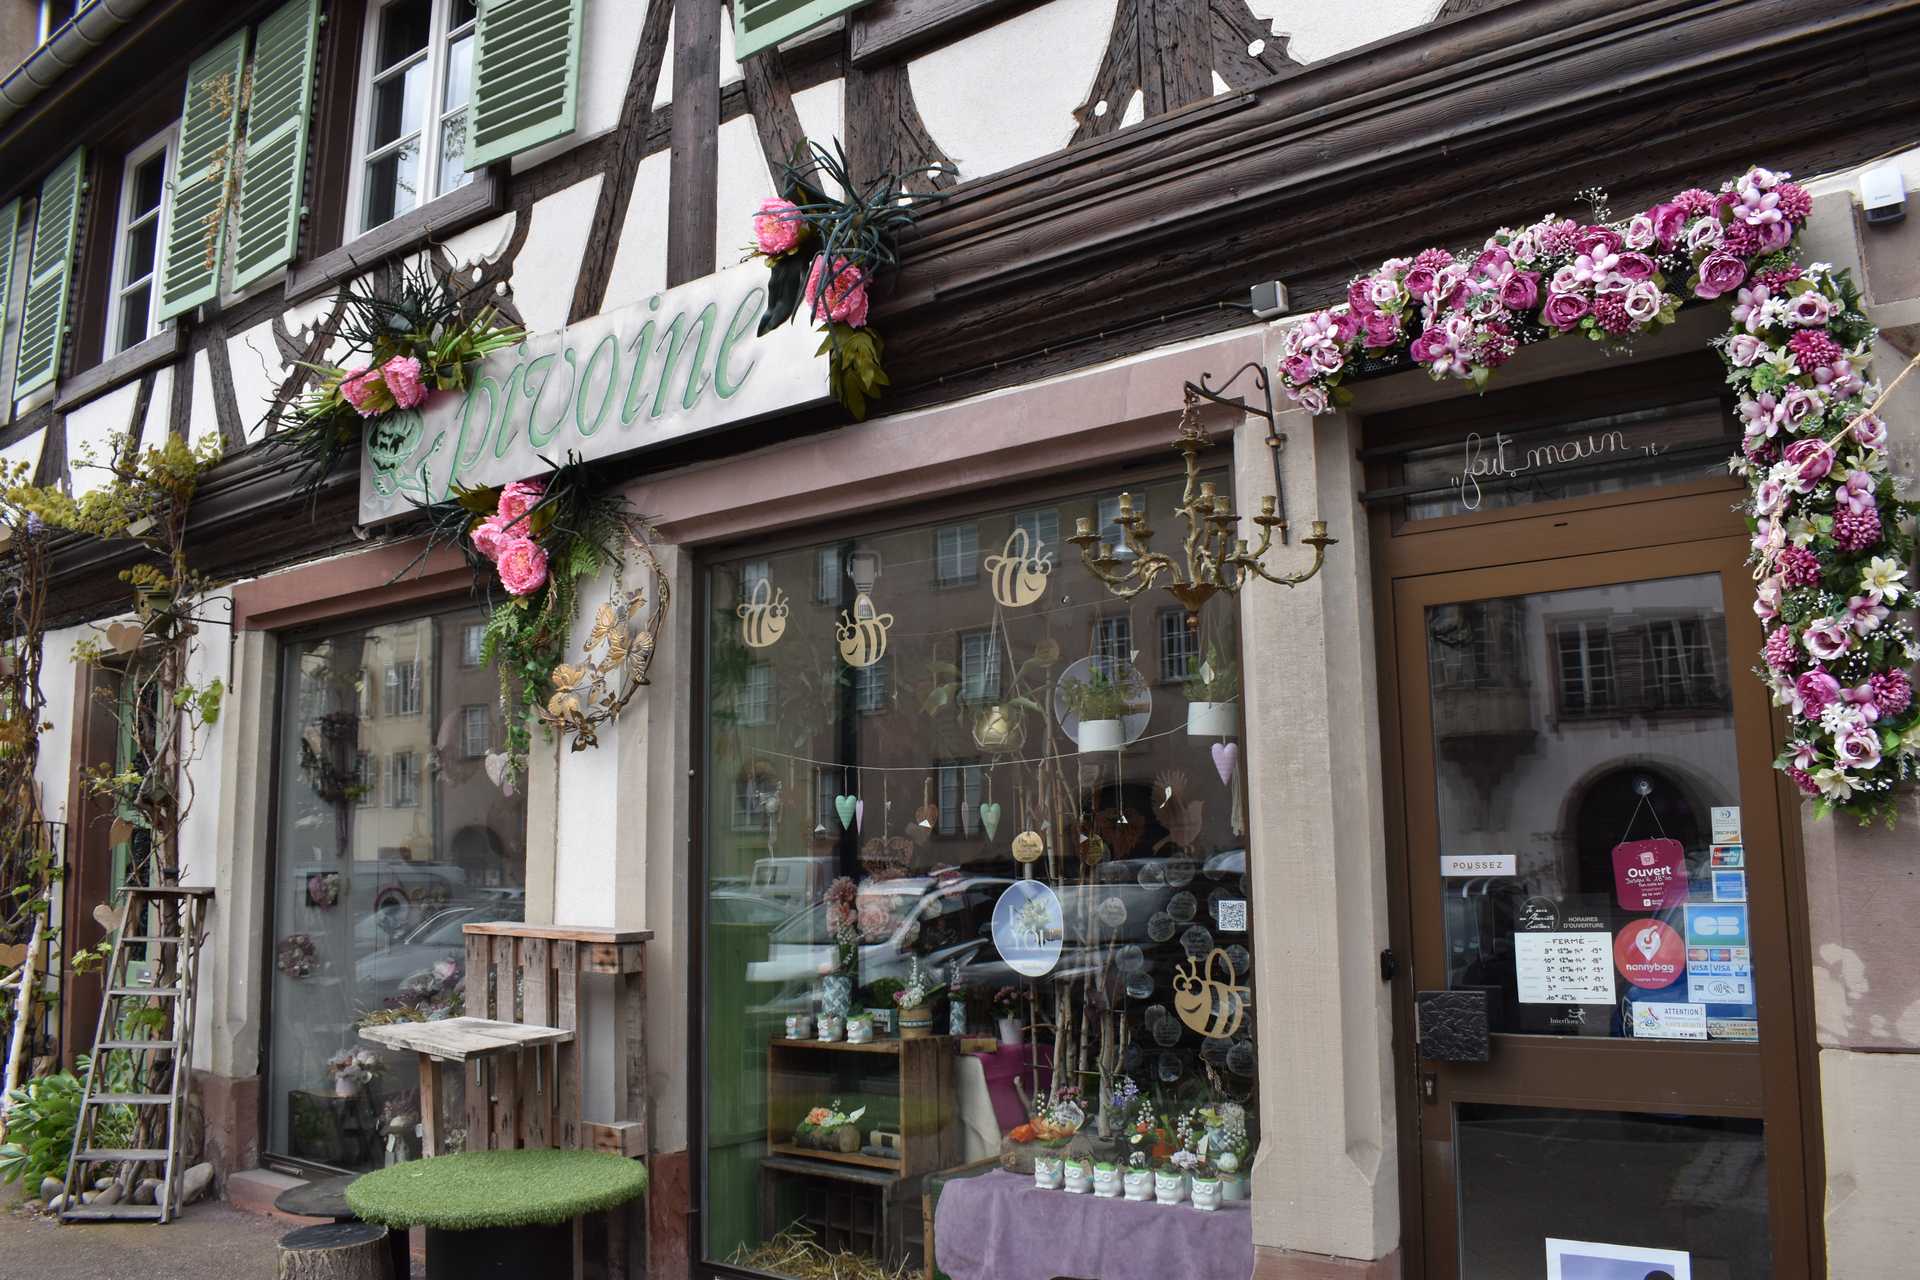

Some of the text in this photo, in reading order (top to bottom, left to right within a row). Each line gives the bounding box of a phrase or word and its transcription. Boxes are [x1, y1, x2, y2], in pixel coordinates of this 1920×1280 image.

[447, 286, 767, 500] pivoine
[1627, 865, 1672, 878] Ouvert
[1693, 916, 1740, 935] CB
[1626, 962, 1674, 973] nannybag
[1664, 1008, 1699, 1016] ATTENTION
